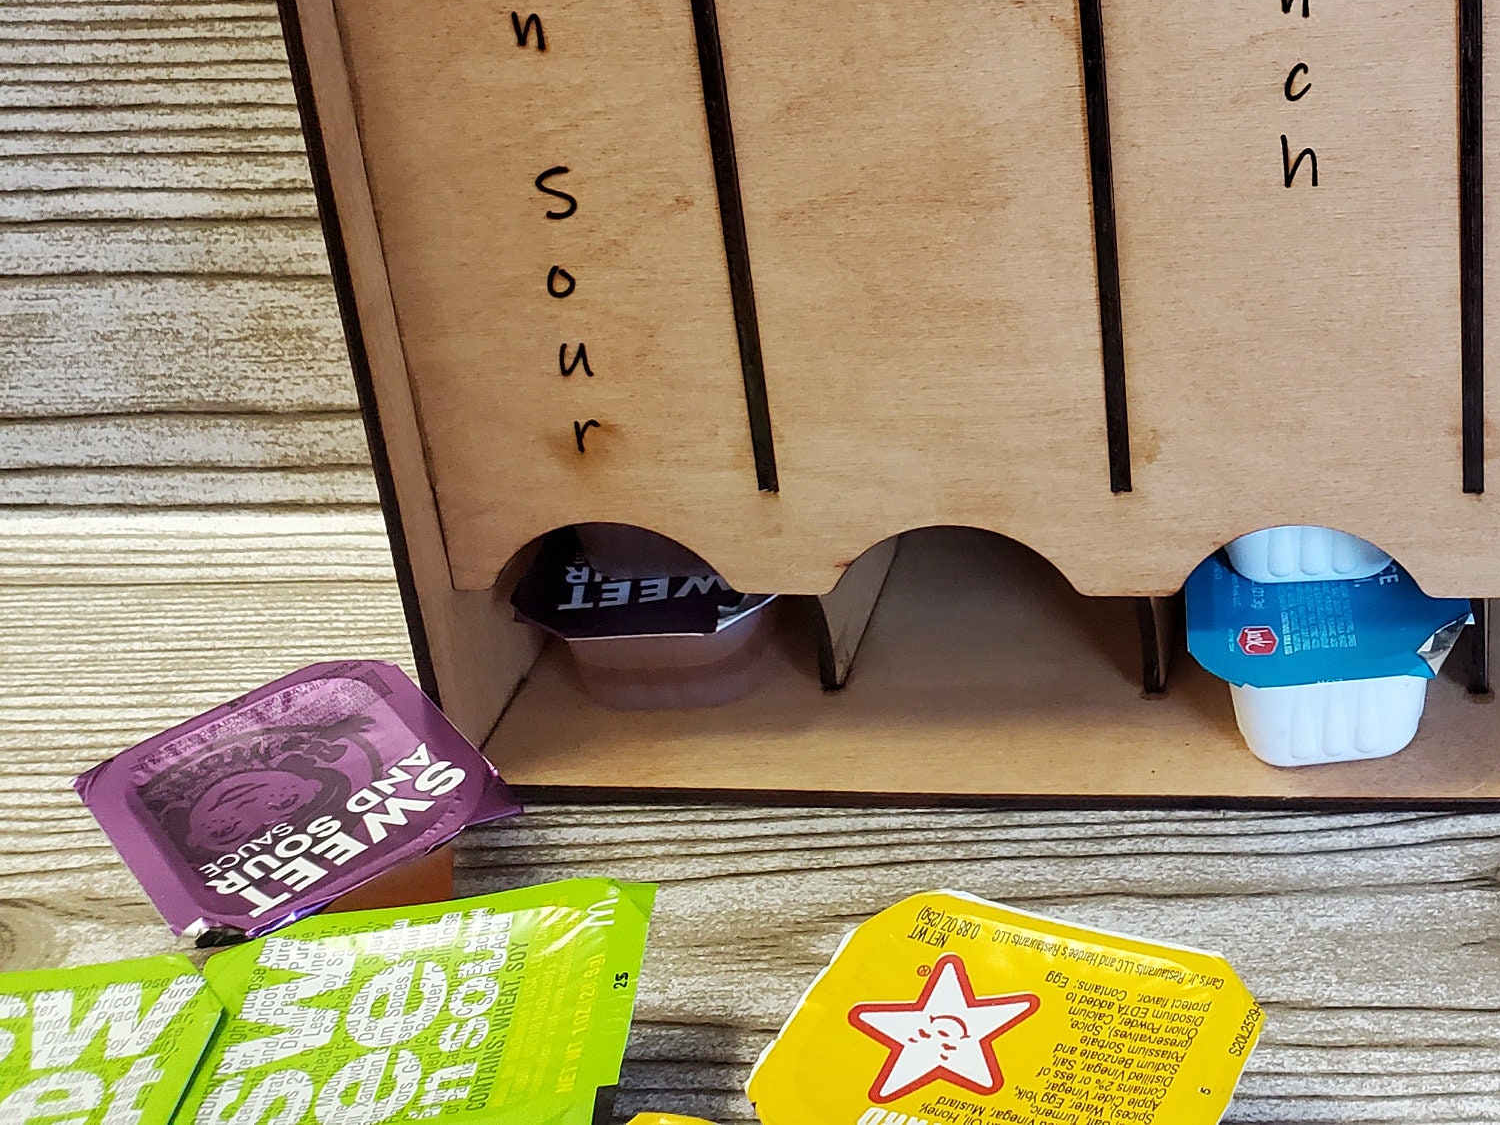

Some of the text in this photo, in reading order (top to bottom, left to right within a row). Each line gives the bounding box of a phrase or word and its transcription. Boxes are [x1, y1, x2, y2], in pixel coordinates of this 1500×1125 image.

[511, 11, 546, 53] n
[535, 166, 601, 455] Sour
[557, 574, 732, 610] WEET
[205, 742, 431, 895] AND SOUR
[238, 761, 466, 918] SWEET
[199, 822, 294, 877] SAUCE
[907, 923, 949, 948] NET WT
[915, 905, 981, 940] 0.88 OZ (25g)
[276, 976, 301, 1015] Peach
[291, 932, 314, 969] Puree
[508, 942, 528, 971] SOY
[991, 929, 1225, 990] Carl's Jr. Restaurants LLC and Hardee's Restaurants LLC
[229, 933, 295, 1091] Water, Apricot Puree
[459, 978, 481, 1016] Color,
[493, 975, 524, 1031] WHEAT,
[1044, 970, 1212, 1014] protect flavor. Contains: Egg
[1065, 991, 1204, 1029] Disodium EDTA added to
[283, 996, 313, 1048] Distilled
[302, 1042, 315, 1056] or
[320, 973, 341, 996] Soy
[307, 1041, 335, 1086] Wheat,
[327, 966, 359, 1033] Soybeans,
[1067, 1006, 1199, 1039] Onion Powder, Calcium
[1070, 1018, 1193, 1055] (preservatives), Spice,
[200, 1057, 234, 1125] REDIENTS:
[225, 1025, 249, 1053] High
[239, 968, 266, 1020] Fructose
[320, 1053, 349, 1106] Modified
[339, 1019, 360, 1049] Food
[351, 970, 377, 1014] Starch,
[341, 1047, 371, 1098] Powder,
[361, 982, 391, 1041] Dextrose,
[356, 1059, 384, 1107] Xanthan
[387, 972, 412, 1016] Spices,
[391, 1077, 416, 1124] Flavors,
[405, 1036, 428, 1073] Garlic
[419, 978, 446, 1030] Powder,
[421, 1051, 441, 1084] Dried
[433, 1017, 450, 1045] Chili
[1052, 1042, 1180, 1076] Sodium Benzoate and
[1079, 1035, 1186, 1065] Potassium Sorbate
[451, 1056, 476, 1100] Paprika
[469, 1034, 505, 1110] CONTAINS:
[1035, 1066, 1167, 1100] Contains 2% or less of
[1052, 1054, 1174, 1088] Distilled Vinegar, Salt,
[919, 1102, 960, 1123] Honey,
[934, 1096, 987, 1116] Mustard
[1014, 1085, 1155, 1125] Spices), Water, Egg Yolk,
[1029, 1103, 1080, 1125] Turmeric,
[1045, 1079, 1162, 1112] Apple Cider Vinegar,
